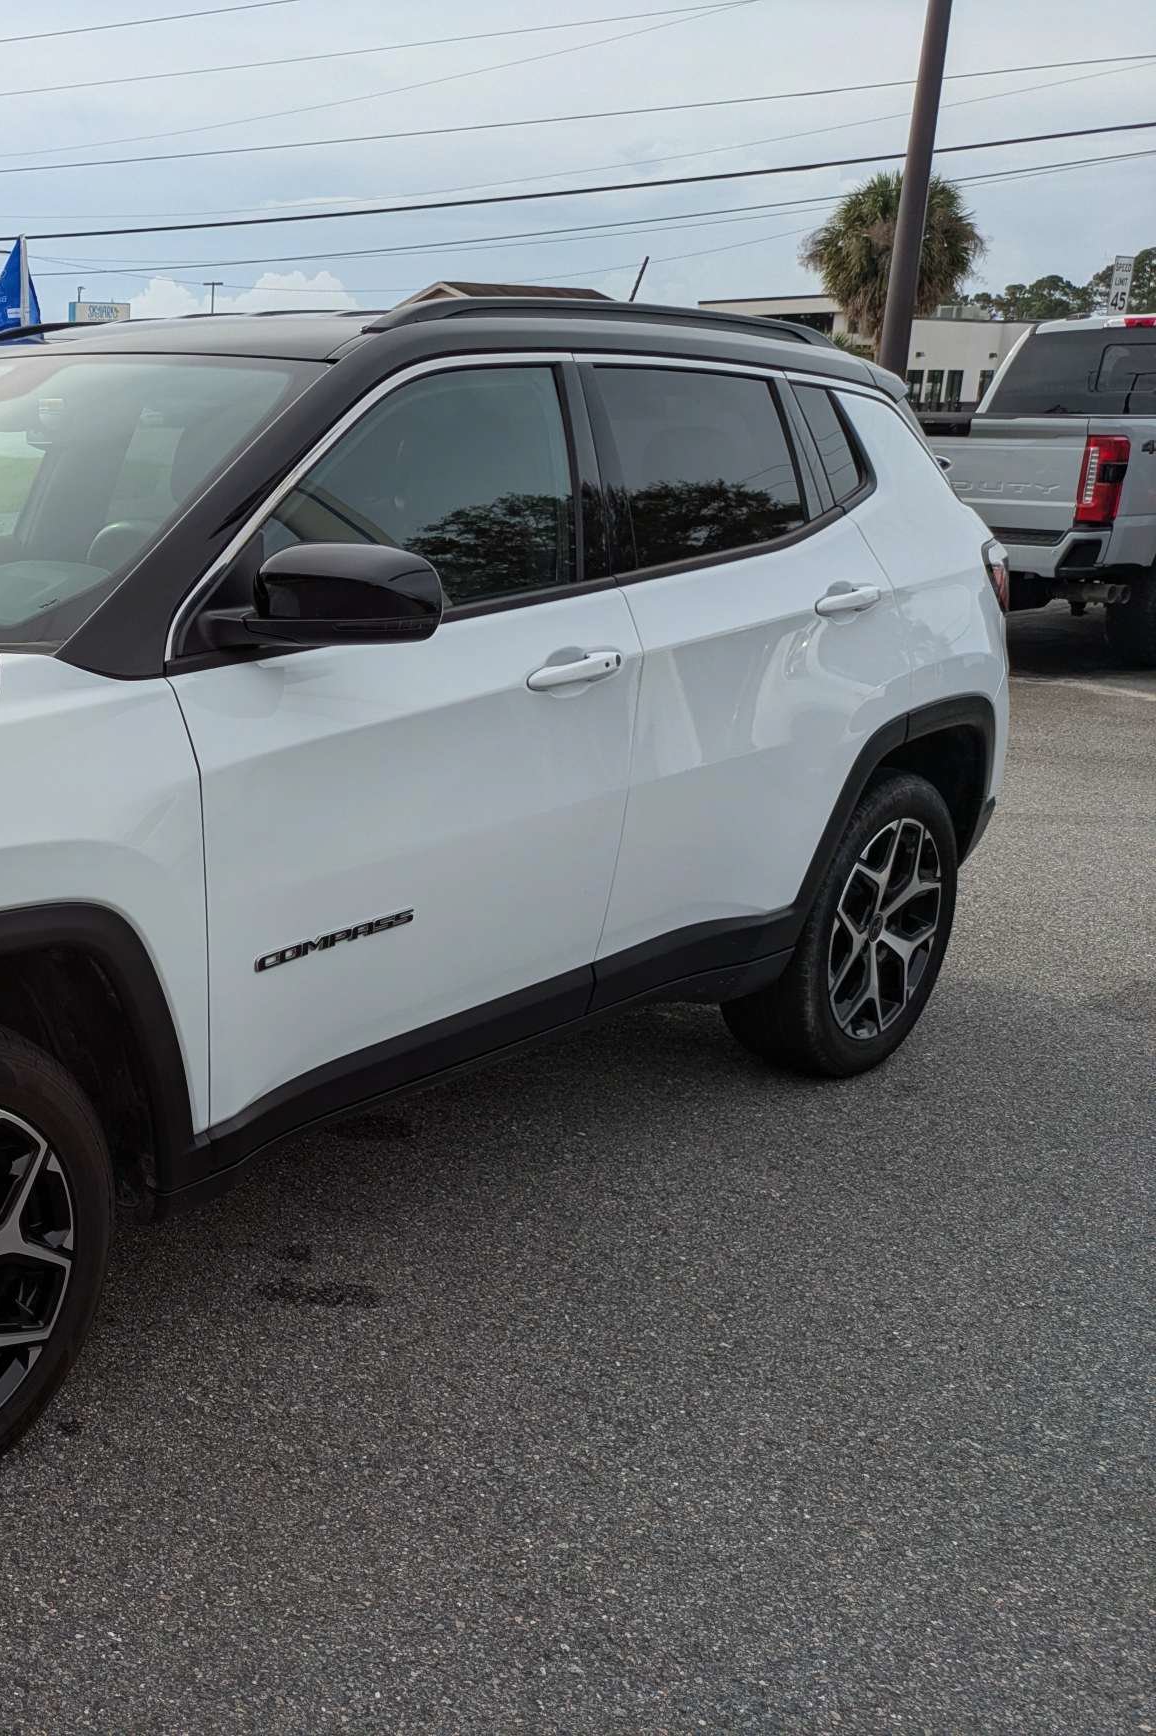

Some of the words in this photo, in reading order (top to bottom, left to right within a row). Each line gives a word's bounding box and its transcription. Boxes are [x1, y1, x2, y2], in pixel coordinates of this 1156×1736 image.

[1115, 262, 1132, 272] SPEED
[1115, 277, 1128, 286] LIMIT
[1111, 291, 1126, 310] 45
[950, 480, 1061, 494] DUTY
[254, 905, 415, 972] COMPASS
